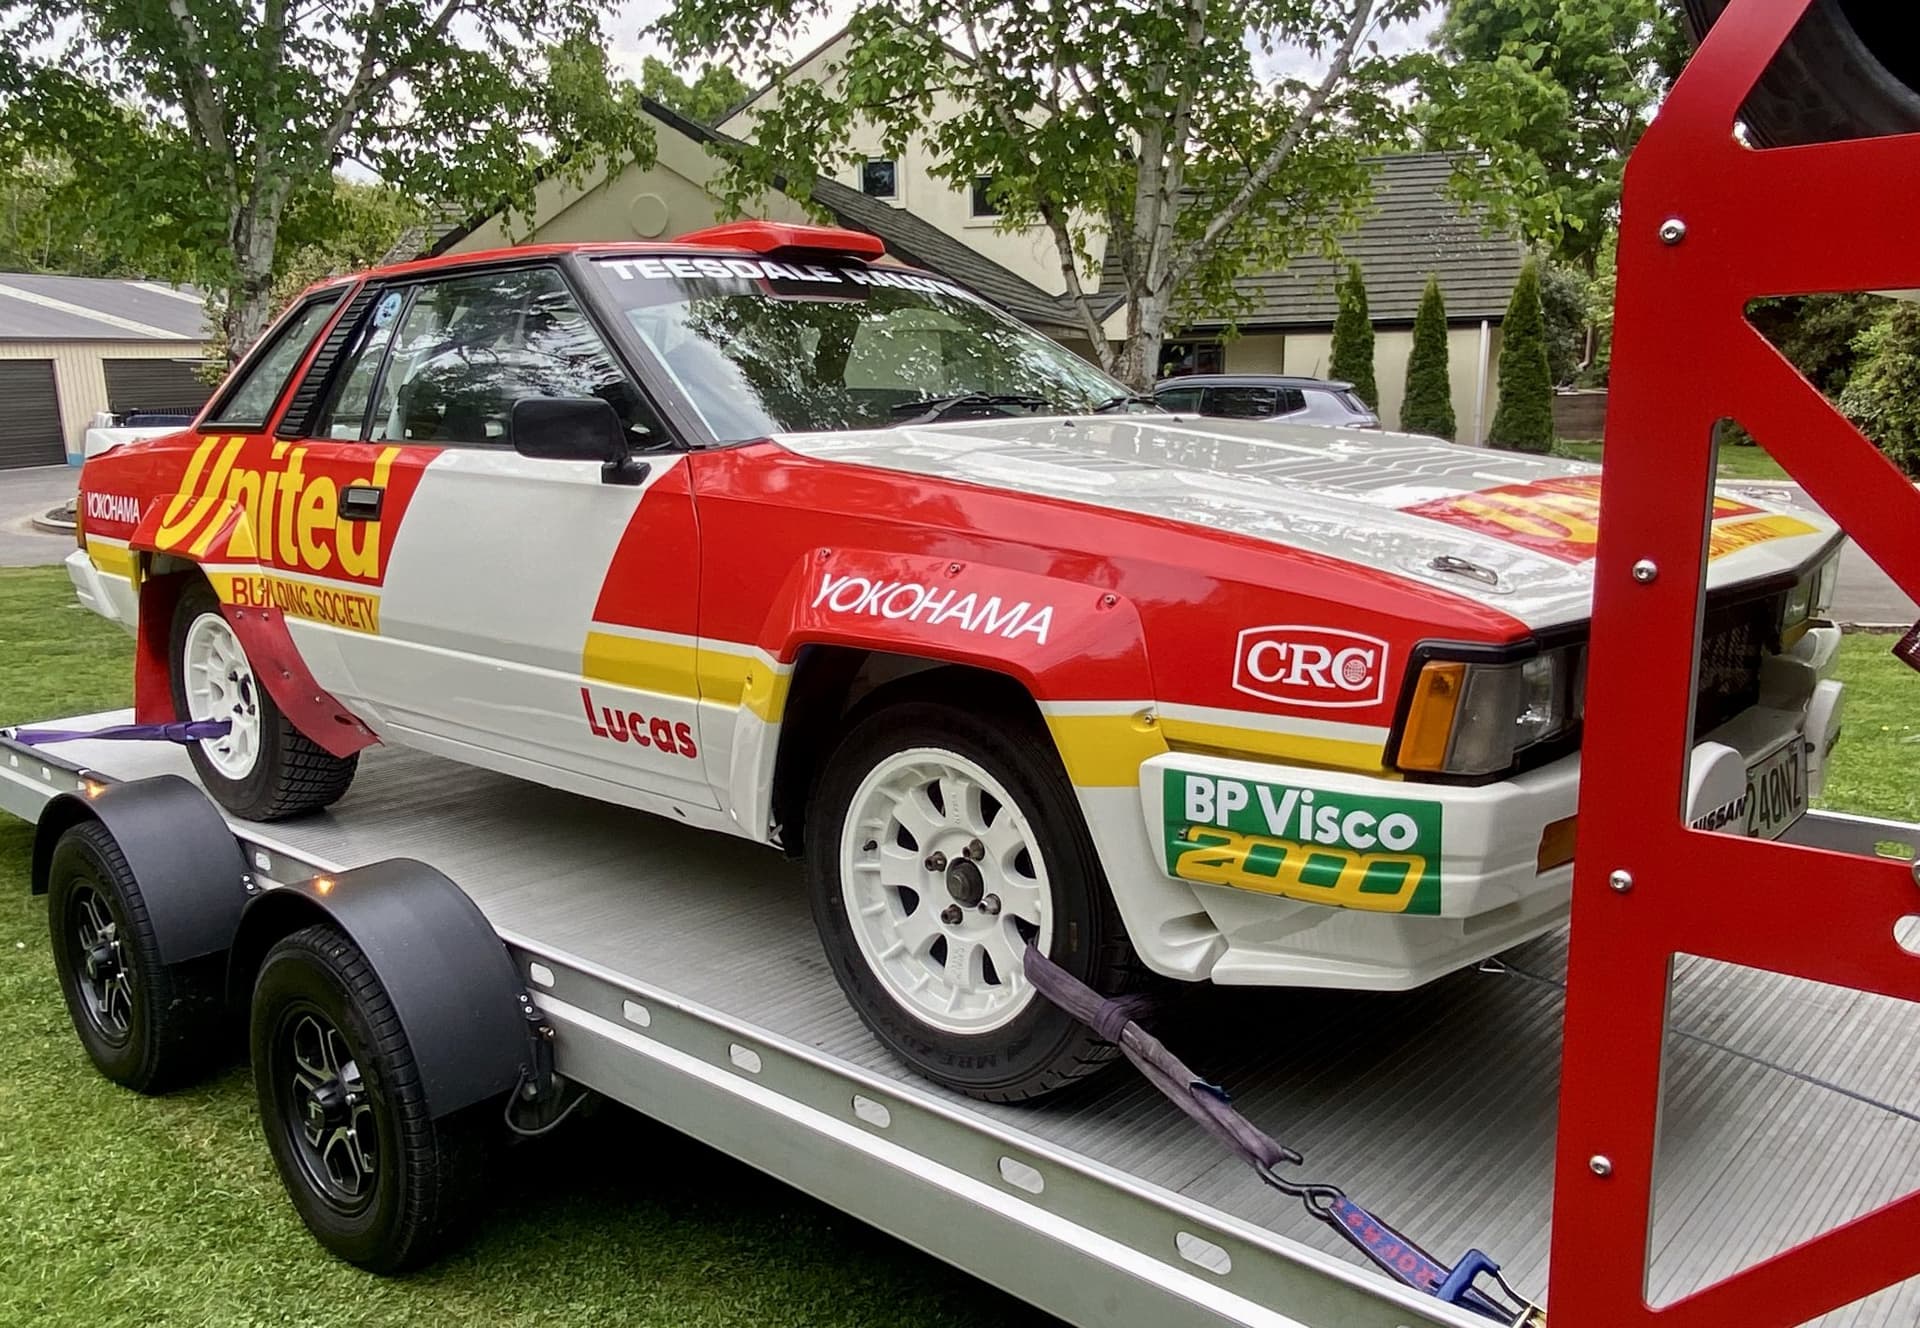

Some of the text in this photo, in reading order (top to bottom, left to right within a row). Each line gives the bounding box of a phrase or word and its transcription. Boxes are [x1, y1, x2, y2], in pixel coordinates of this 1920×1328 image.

[600, 258, 842, 283] TEESDALE
[87, 491, 141, 524] YOKOHAMA
[154, 436, 401, 579] United
[232, 577, 376, 630] BUILDING SOCIETY
[812, 573, 1054, 645] YOKOHAMA
[1246, 640, 1375, 691] CRC
[580, 686, 698, 759] Lucas
[1184, 774, 1419, 851] BP Visco
[1746, 752, 1802, 838] 240NZ
[1175, 825, 1427, 912] 2000
